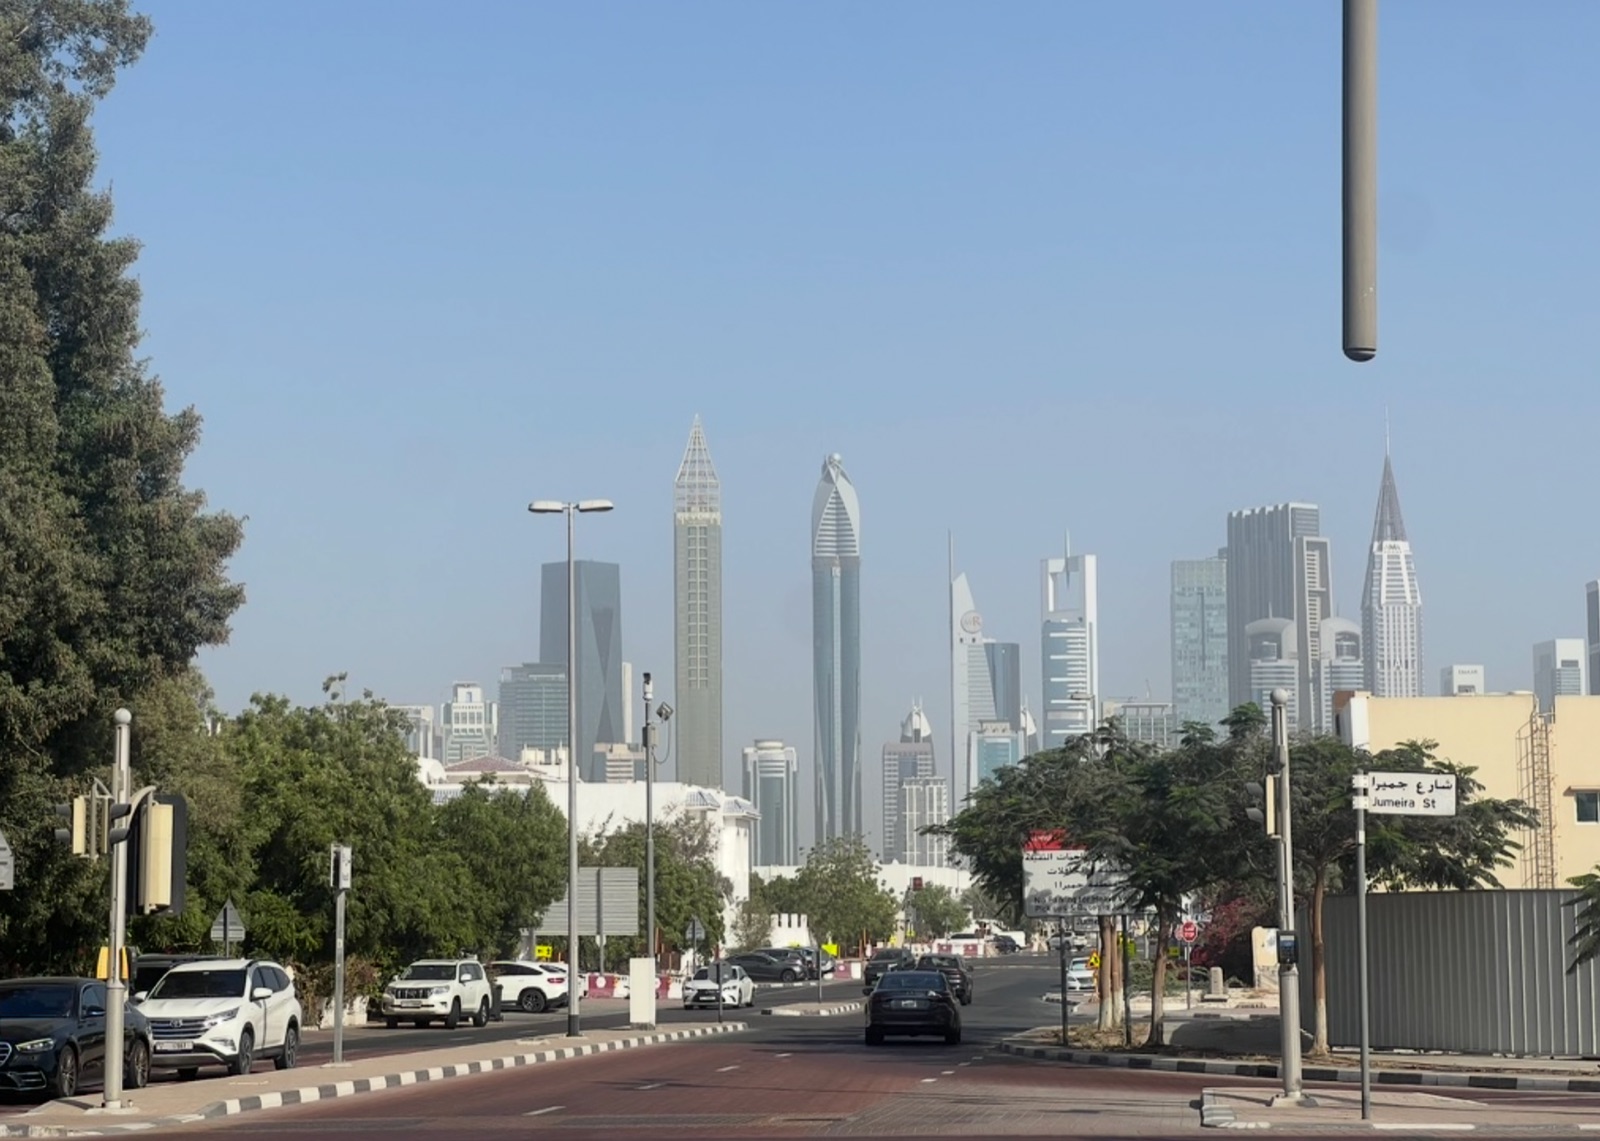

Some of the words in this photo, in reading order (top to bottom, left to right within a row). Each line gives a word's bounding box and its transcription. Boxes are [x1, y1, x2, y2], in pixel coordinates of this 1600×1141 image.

[1372, 776, 1408, 791] جميرا
[1416, 778, 1453, 795] شارع
[1372, 797, 1415, 808] Jumeira
[1423, 797, 1436, 809] St
